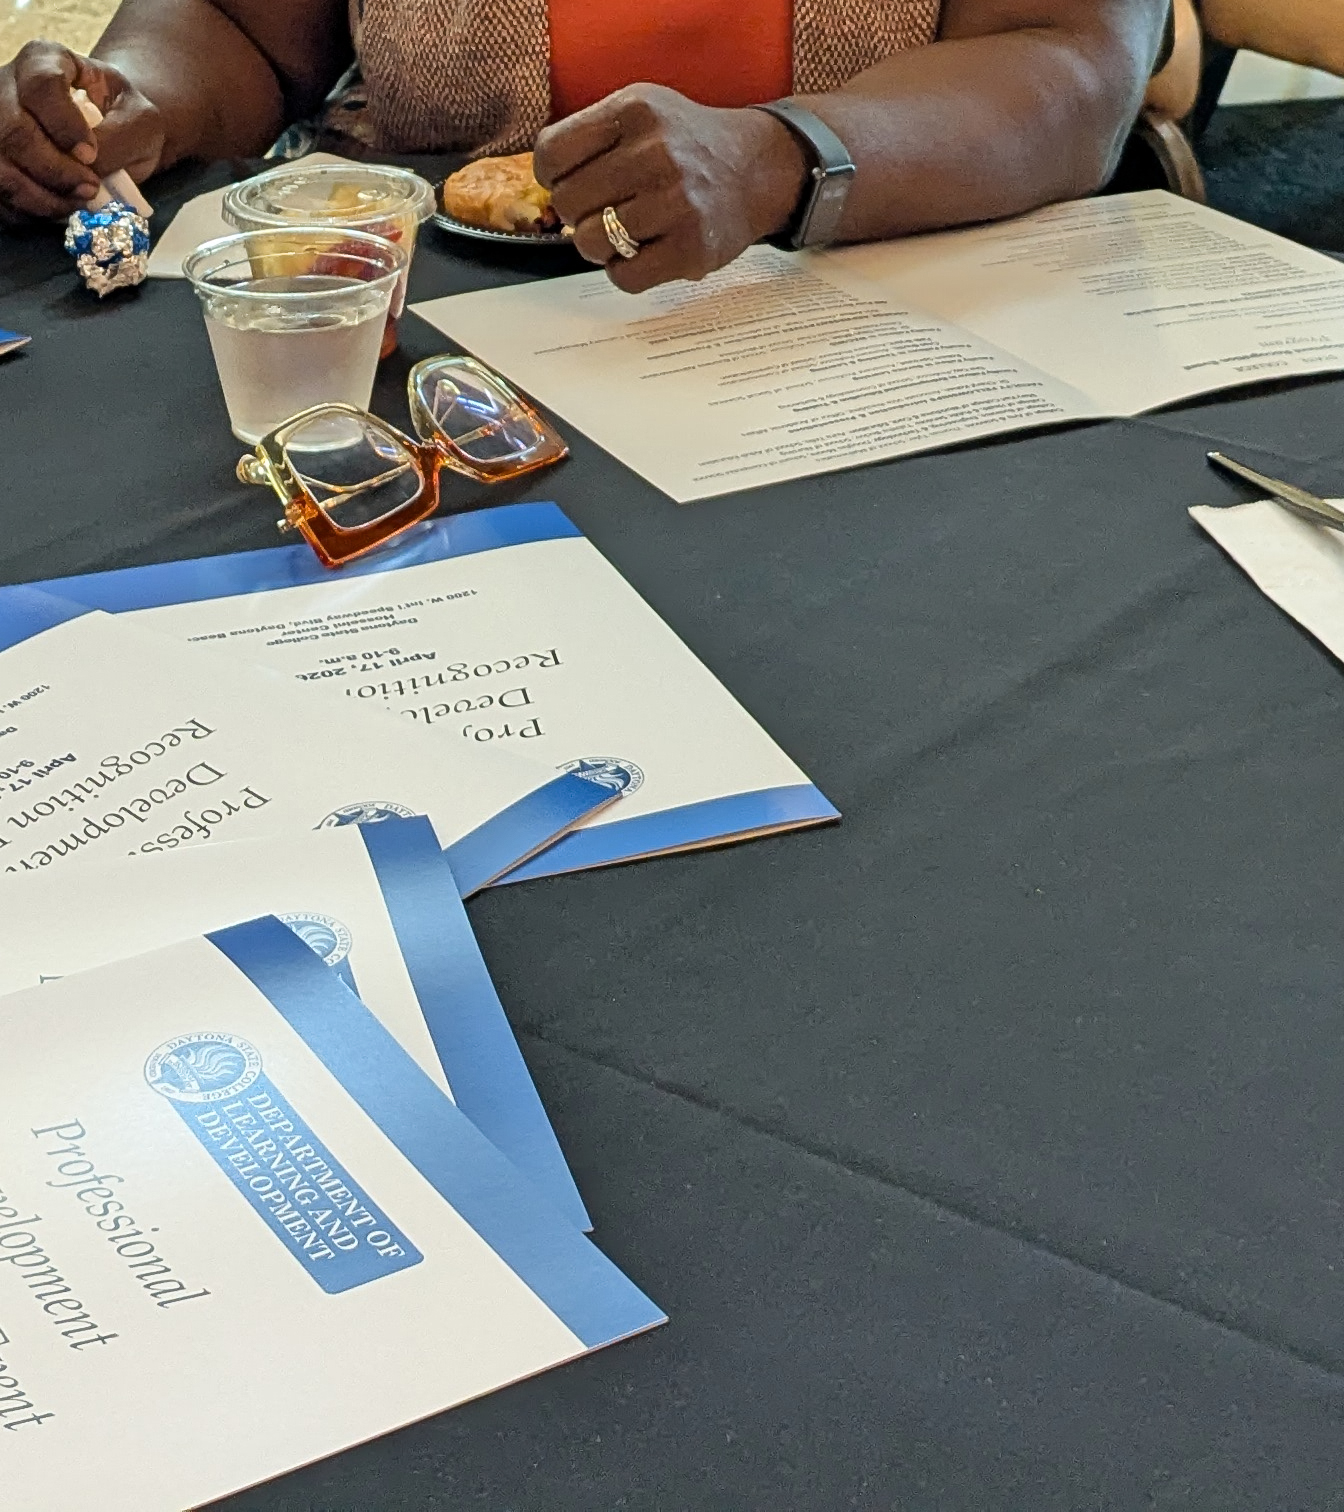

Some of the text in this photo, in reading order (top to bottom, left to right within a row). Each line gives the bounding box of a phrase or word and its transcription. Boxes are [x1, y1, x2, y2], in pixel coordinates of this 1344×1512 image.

[446, 589, 478, 600] 1200
[229, 623, 286, 636] Daytona
[266, 617, 418, 646] Daytona State College
[281, 625, 330, 637] Center
[318, 647, 401, 665] 9-10 a.m.
[350, 662, 384, 672] 17,
[388, 651, 436, 667] April
[2, 700, 22, 709] W.
[6, 719, 216, 829] Recognition
[31, 752, 77, 778] April
[127, 787, 272, 856] Profess
[166, 1032, 234, 1050] DAYTONA
[236, 1040, 260, 1068] STATE
[194, 1109, 336, 1260] DEVELOPMENT
[221, 1100, 359, 1250] LEARNING AND
[246, 1090, 406, 1257] DEPARTMENT OF
[31, 1118, 212, 1309] Professional
